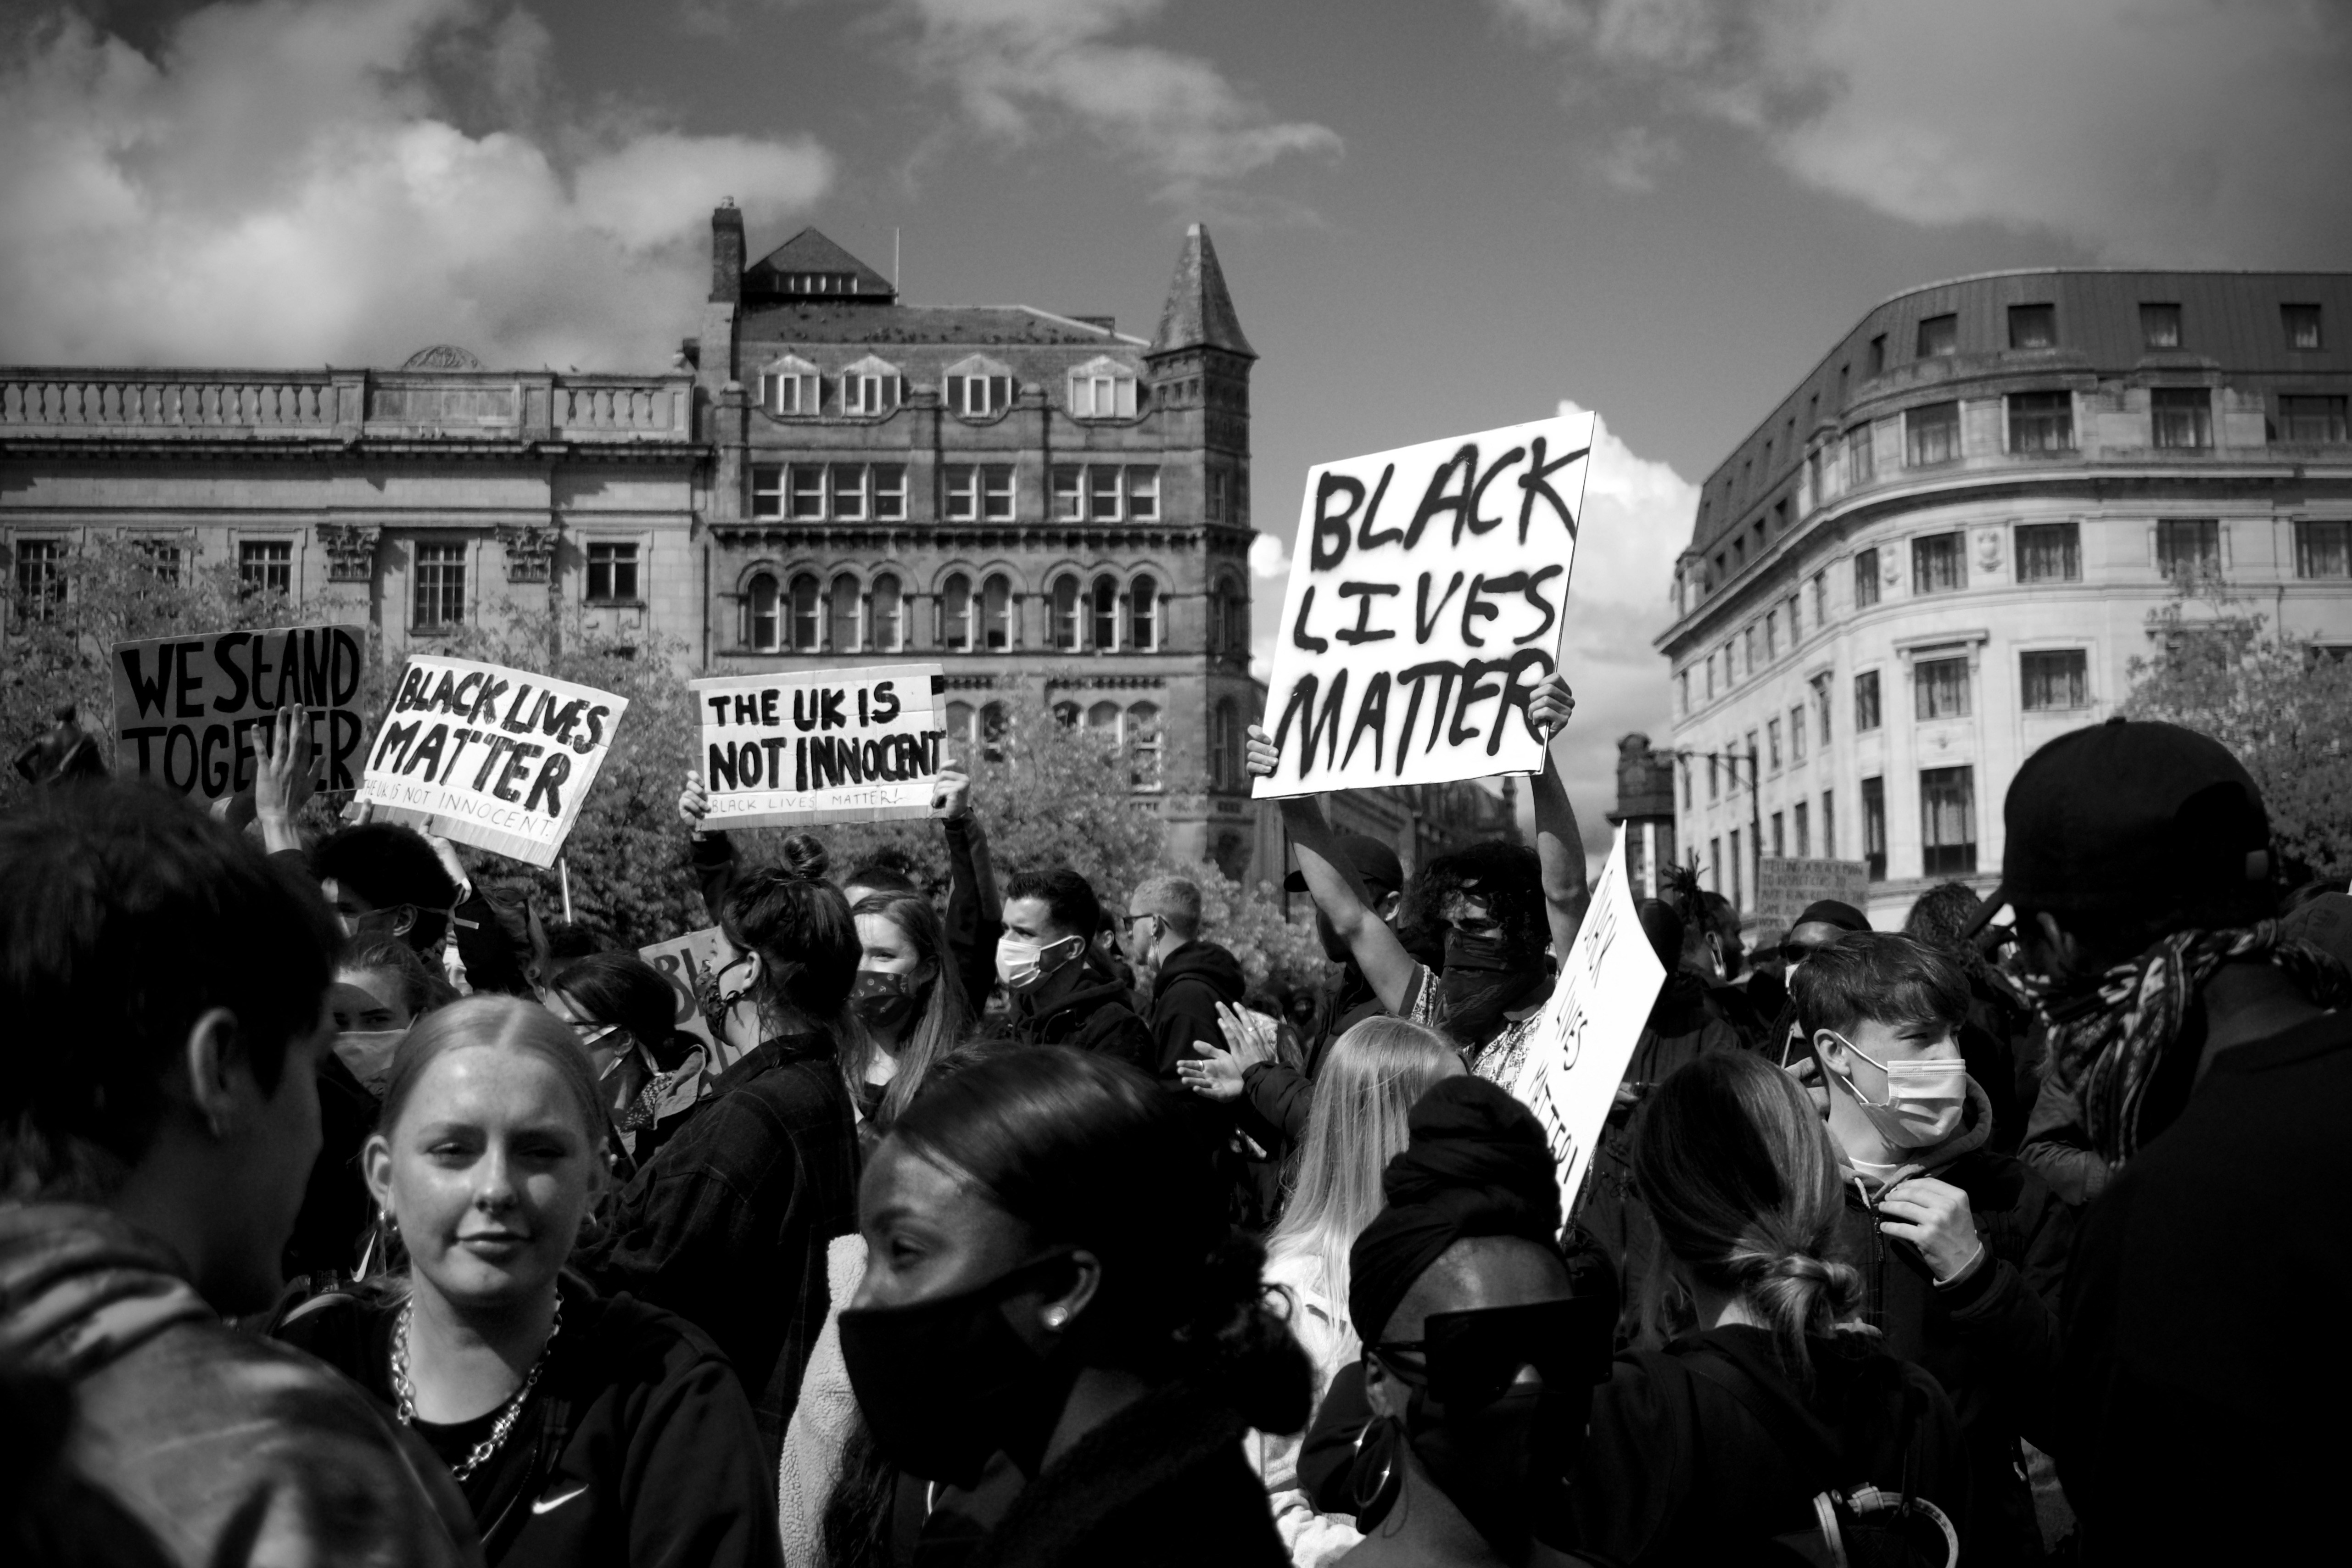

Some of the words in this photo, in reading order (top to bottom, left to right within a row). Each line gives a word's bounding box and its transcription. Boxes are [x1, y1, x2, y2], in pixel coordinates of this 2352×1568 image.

[1311, 436, 1590, 573] BLACK
[1293, 564, 1564, 654] LIVES
[120, 642, 204, 720] WE
[395, 667, 509, 725] BLACK
[500, 684, 610, 754] LIVES
[708, 689, 781, 727] THE
[793, 688, 847, 732] UK
[858, 681, 901, 727] IS
[1264, 648, 1556, 780] MATTER
[361, 779, 378, 795] THE
[377, 781, 389, 798] UK
[390, 783, 401, 800] IS
[403, 787, 432, 804] NOT
[373, 720, 572, 818] MATTER
[709, 737, 788, 792] NOT
[795, 727, 947, 792] INNOCENT
[712, 798, 757, 813] BLACK
[769, 796, 816, 809] LIVES
[832, 787, 903, 805] MATTER!
[1584, 868, 1617, 989] BLACK
[1555, 975, 1588, 1071] LIVES
